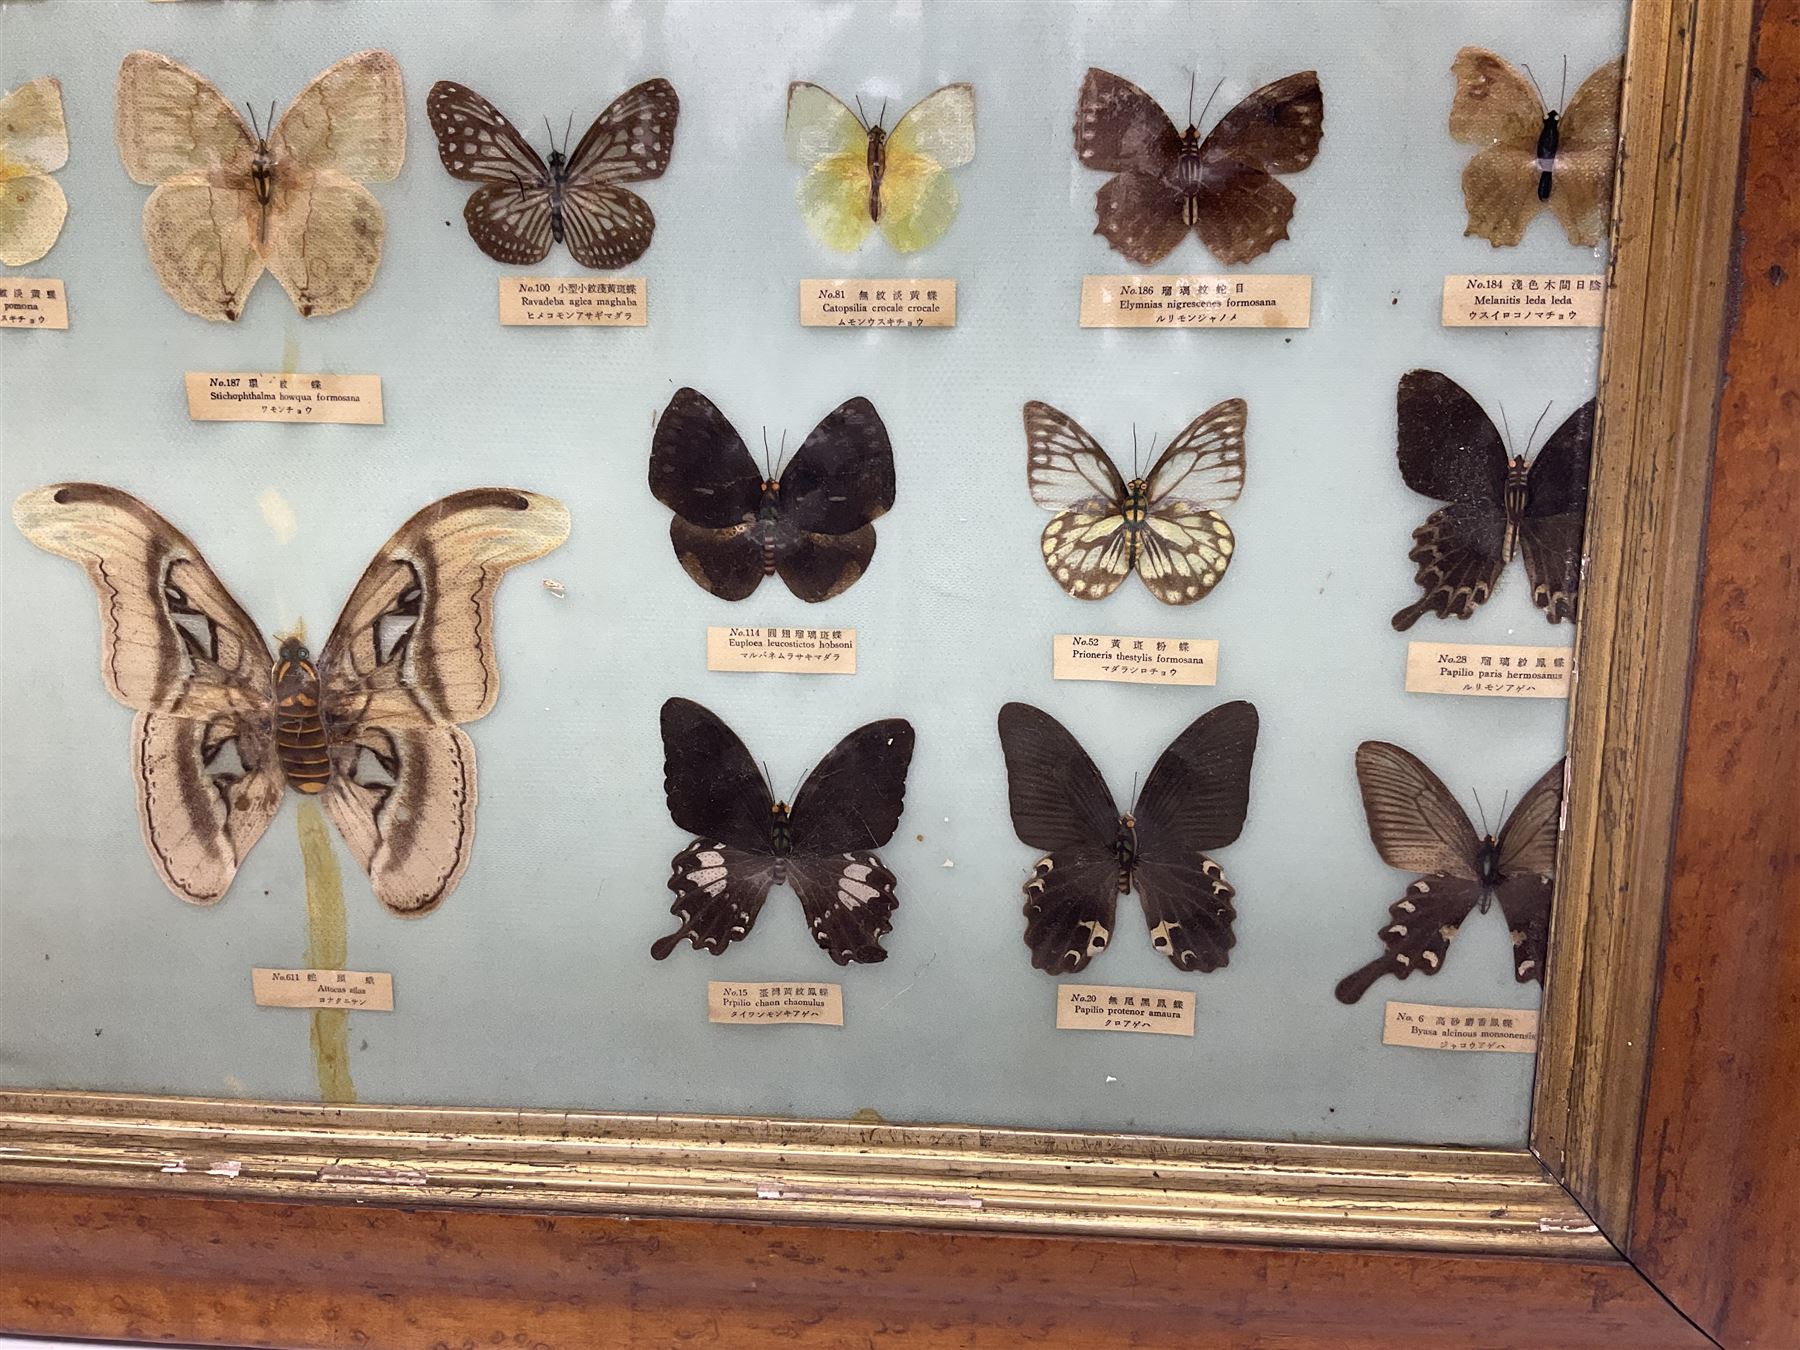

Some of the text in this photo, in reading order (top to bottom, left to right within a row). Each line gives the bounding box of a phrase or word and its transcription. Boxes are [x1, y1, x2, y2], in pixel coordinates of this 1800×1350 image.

[518, 283, 551, 293] No.100
[1466, 279, 1503, 289] No.184
[818, 289, 845, 299] No.81
[1119, 285, 1154, 296] No.186
[521, 297, 637, 307] Ravadeba aglea maghaba
[1119, 300, 1163, 310] Elymnias
[1226, 298, 1277, 307] formosana
[1474, 295, 1572, 305] Melanitis leda leda
[4, 303, 39, 311] pomona
[822, 303, 940, 314] Catopsilia crocale crocale
[209, 378, 240, 387] No.187
[210, 392, 360, 402] Stichophthalma howqua formosana
[729, 628, 760, 637] No.114
[729, 639, 853, 649] Euploea leucostictos hobsoni
[1072, 636, 1099, 646] No.52
[1072, 650, 1204, 664] Prioneris thestylis formosana
[1437, 654, 1467, 664] No.28
[1440, 667, 1563, 679] Papilio paris hermosanus
[272, 972, 299, 981] No.611
[723, 988, 748, 997] No.15
[755, 999, 780, 1007] chaon
[783, 999, 825, 1007] chaonulus
[1070, 993, 1097, 1003] No.20
[1074, 1005, 1181, 1019] Papilio protenor amaura
[1396, 1012, 1414, 1021] No.
[1418, 1015, 1424, 1023] 6
[1105, 1019, 1151, 1028] クロアゲハ
[1411, 1026, 1437, 1036] Byasa
[1442, 1028, 1477, 1038] alcinous
